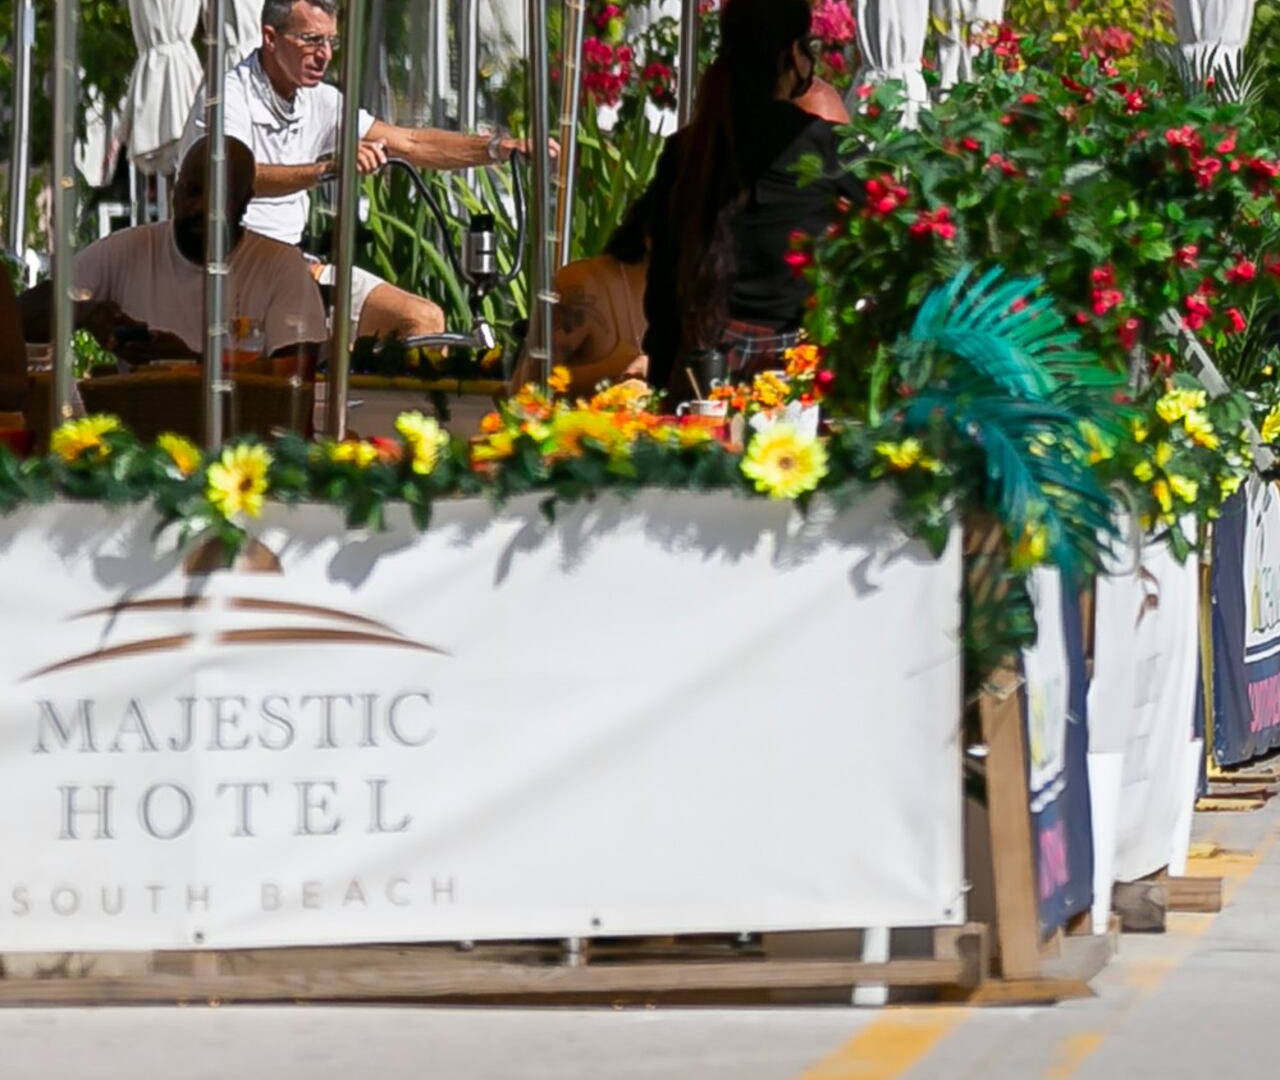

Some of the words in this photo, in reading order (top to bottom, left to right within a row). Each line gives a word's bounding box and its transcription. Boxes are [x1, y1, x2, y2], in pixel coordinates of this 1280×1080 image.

[32, 691, 437, 755] MAJESTIC
[55, 778, 413, 841] HOTEL
[10, 883, 210, 917] SOUTH
[259, 875, 456, 913] BEACH
